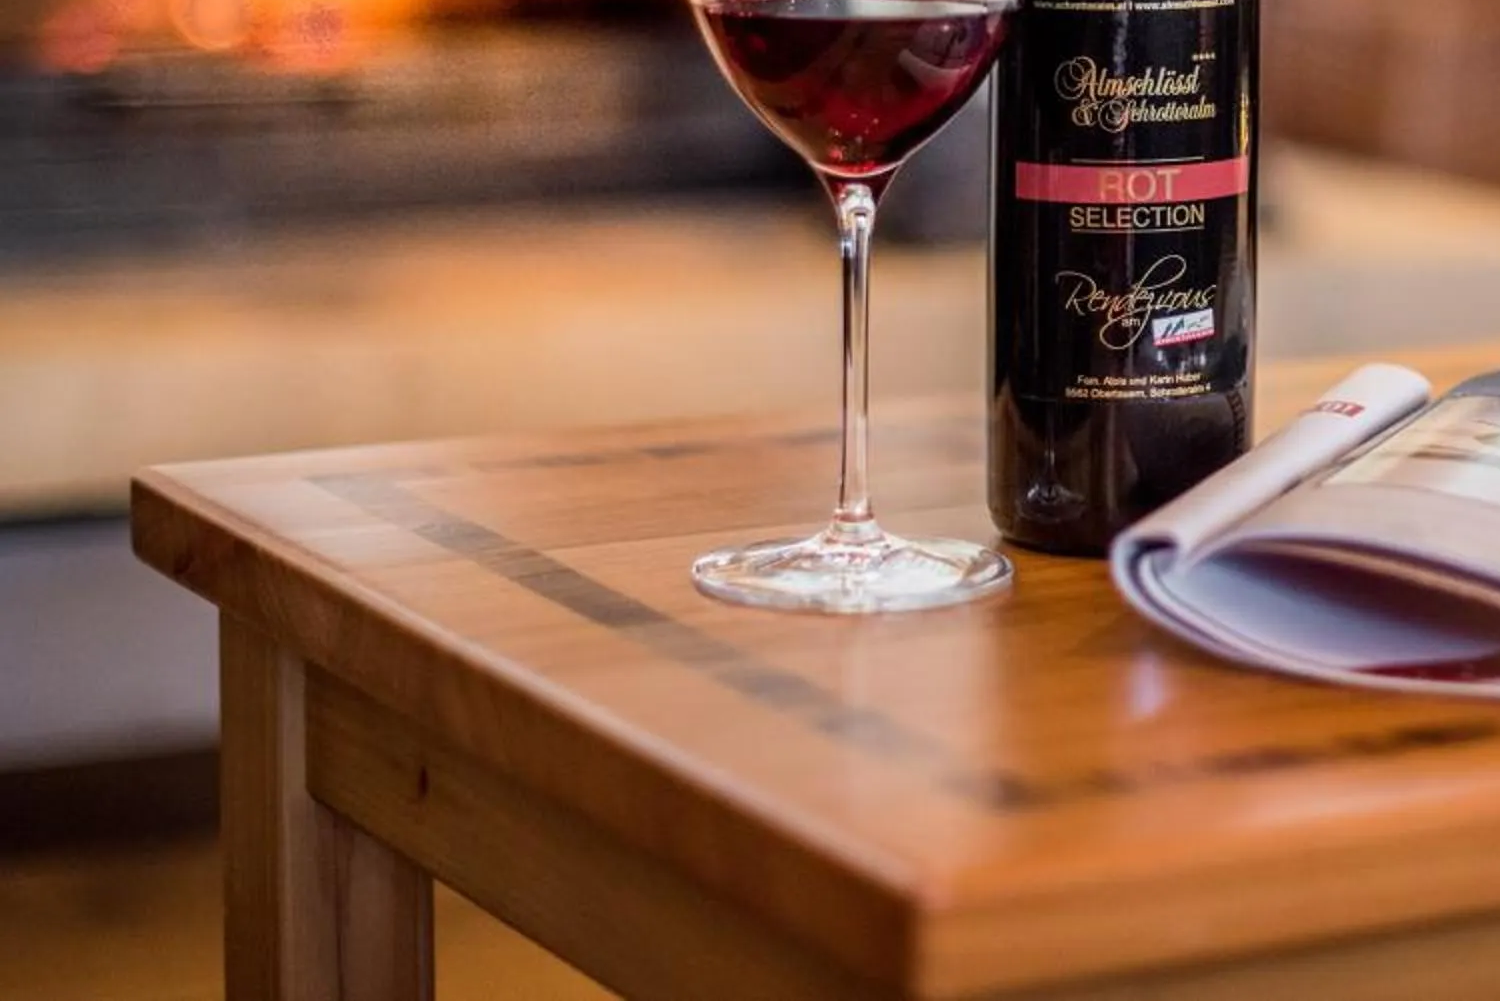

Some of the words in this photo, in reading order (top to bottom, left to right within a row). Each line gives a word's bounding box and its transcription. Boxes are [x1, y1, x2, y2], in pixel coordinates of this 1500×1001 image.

[1101, 168, 1181, 202] ROT
[1069, 203, 1205, 228] SELECTION
[1055, 254, 1217, 349] Rendezvous
[1120, 316, 1142, 328] am
